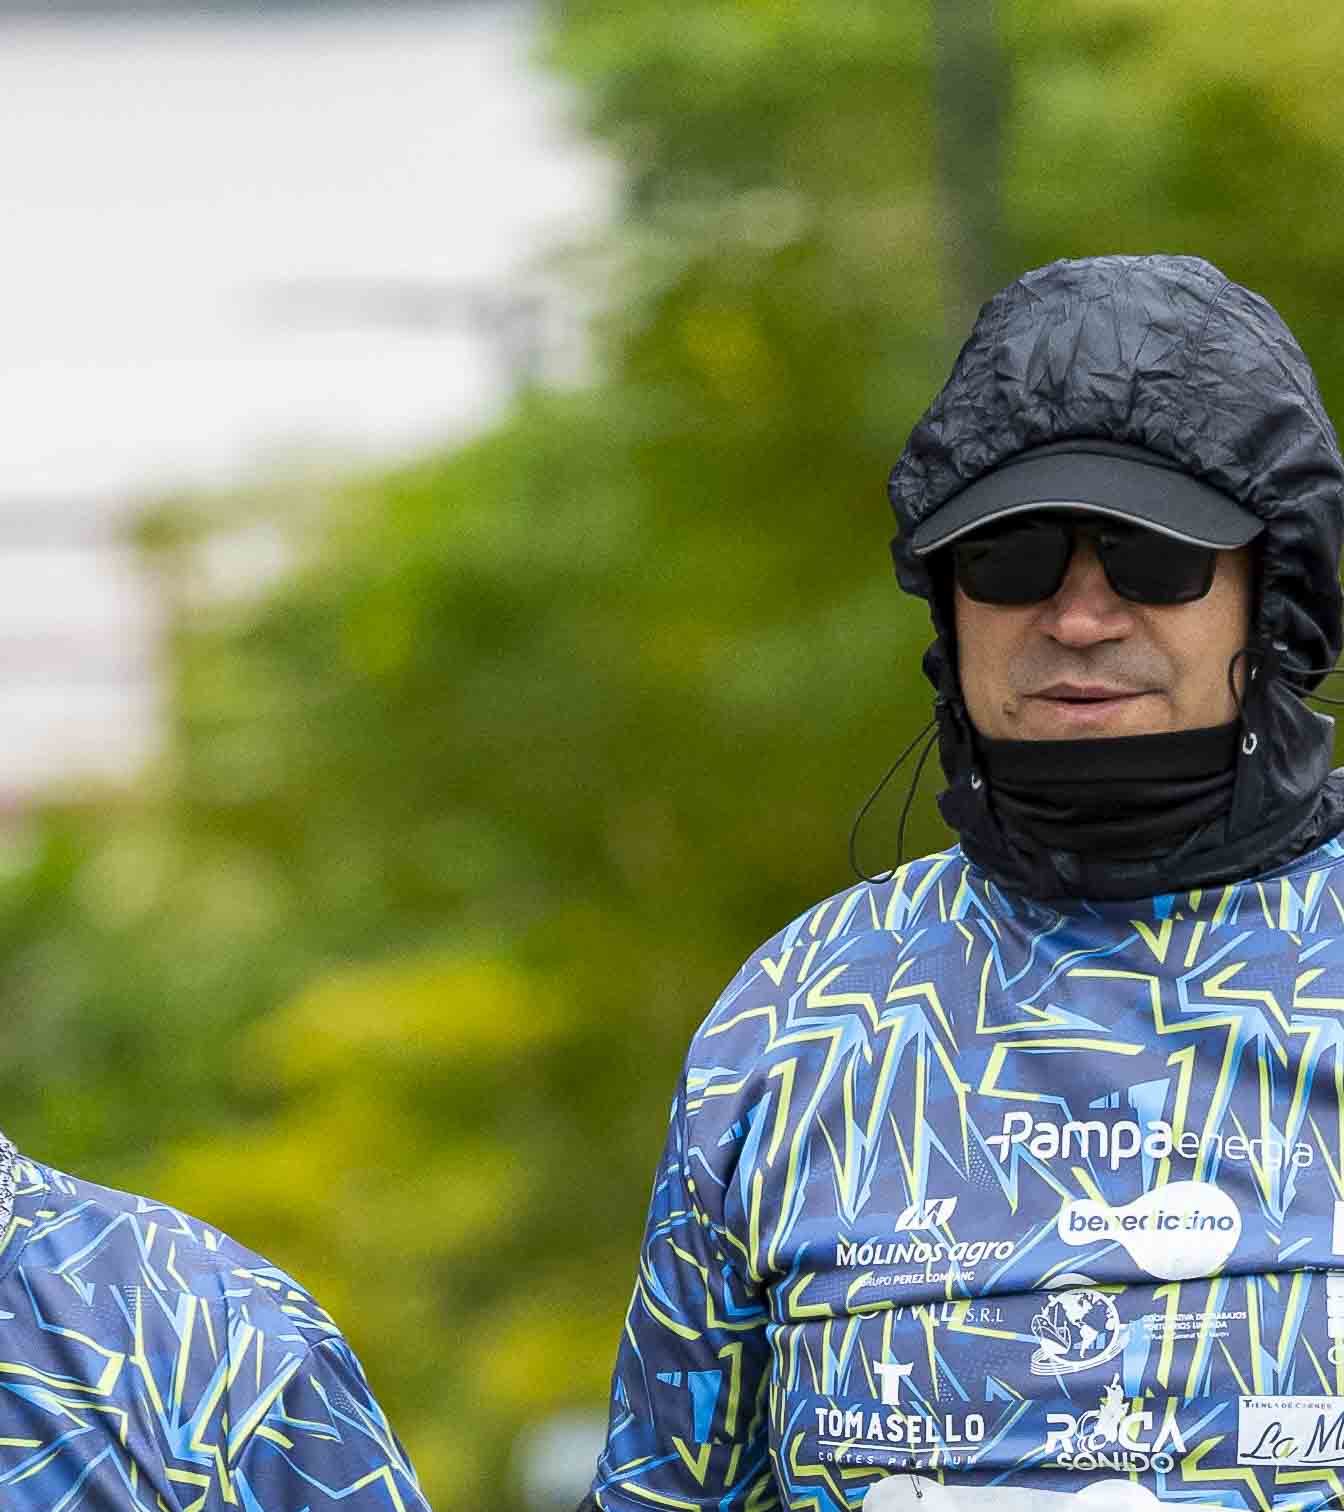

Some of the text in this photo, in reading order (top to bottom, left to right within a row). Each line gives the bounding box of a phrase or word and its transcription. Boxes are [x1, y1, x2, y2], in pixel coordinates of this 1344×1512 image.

[984, 1111, 1172, 1170] Pampa
[1069, 1208, 1235, 1232] benedictino
[835, 1240, 1016, 1267] MOLINOS agro
[893, 1274, 925, 1285] PEREZ
[815, 1407, 985, 1443] TOMASELLO
[1240, 1421, 1299, 1459] La
[1056, 1451, 1175, 1474] SONIDO
